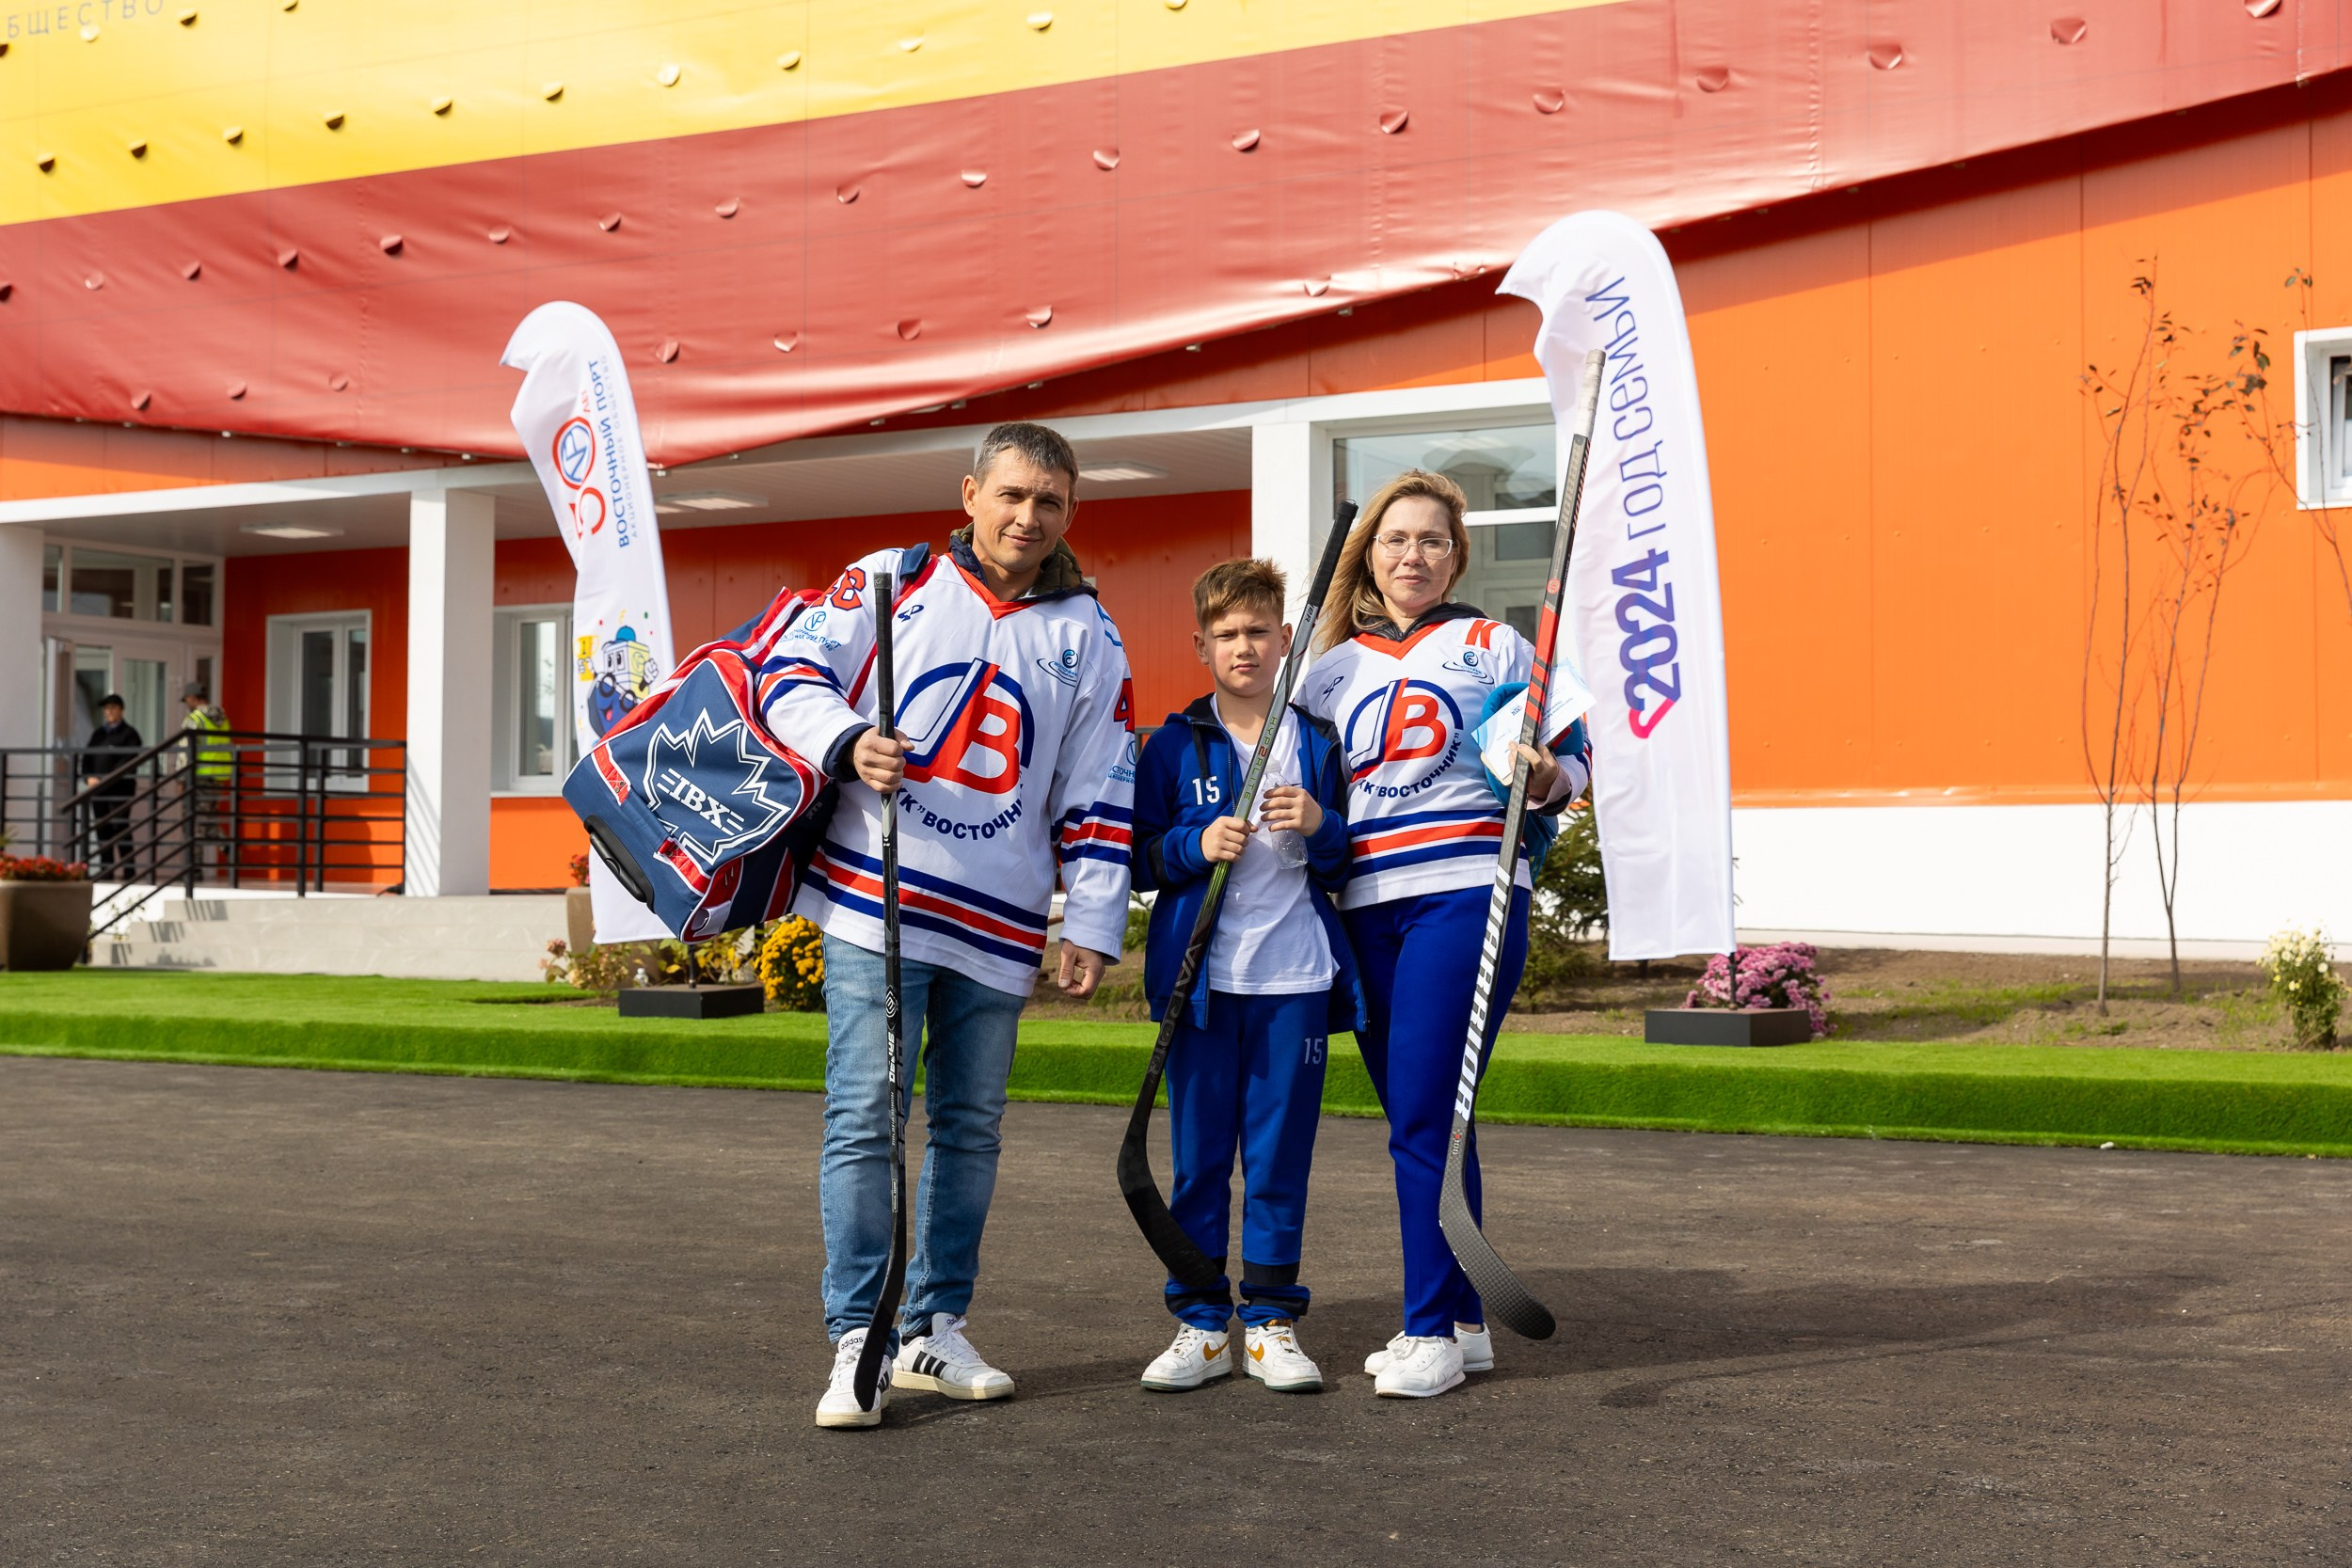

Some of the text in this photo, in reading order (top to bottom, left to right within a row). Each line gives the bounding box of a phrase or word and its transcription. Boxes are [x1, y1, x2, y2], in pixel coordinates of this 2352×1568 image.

[588, 360, 629, 547] ВОСТОЧНЫЙ ПОРТ
[617, 437, 638, 538] АКЦИОНЕРНОЕ
[1618, 439, 1666, 540] ГОД
[1612, 548, 1682, 715] 2024
[1192, 776, 1220, 806] 15
[1454, 867, 1510, 1122] WARRIOR
[1304, 1037, 1324, 1064] 15
[840, 1335, 864, 1350] adidas
